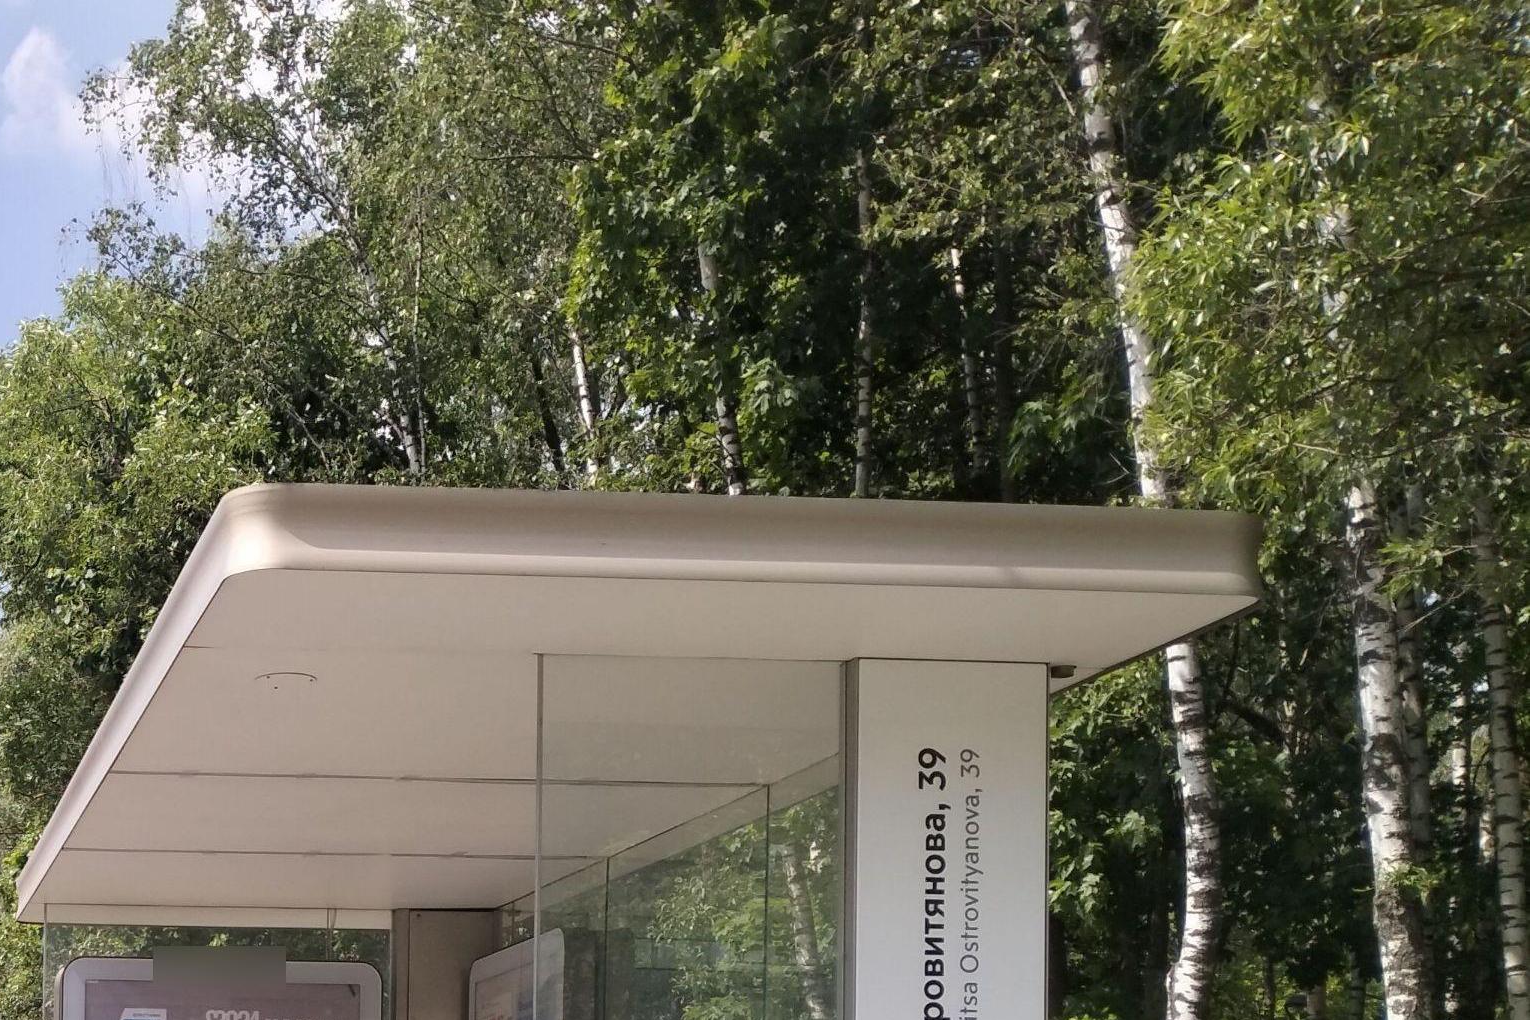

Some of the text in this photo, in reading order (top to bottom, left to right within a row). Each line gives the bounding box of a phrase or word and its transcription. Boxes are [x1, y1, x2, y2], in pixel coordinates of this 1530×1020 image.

[917, 747, 946, 791] 39
[959, 748, 980, 778] 39
[959, 788, 983, 973] Ostrovityanova,
